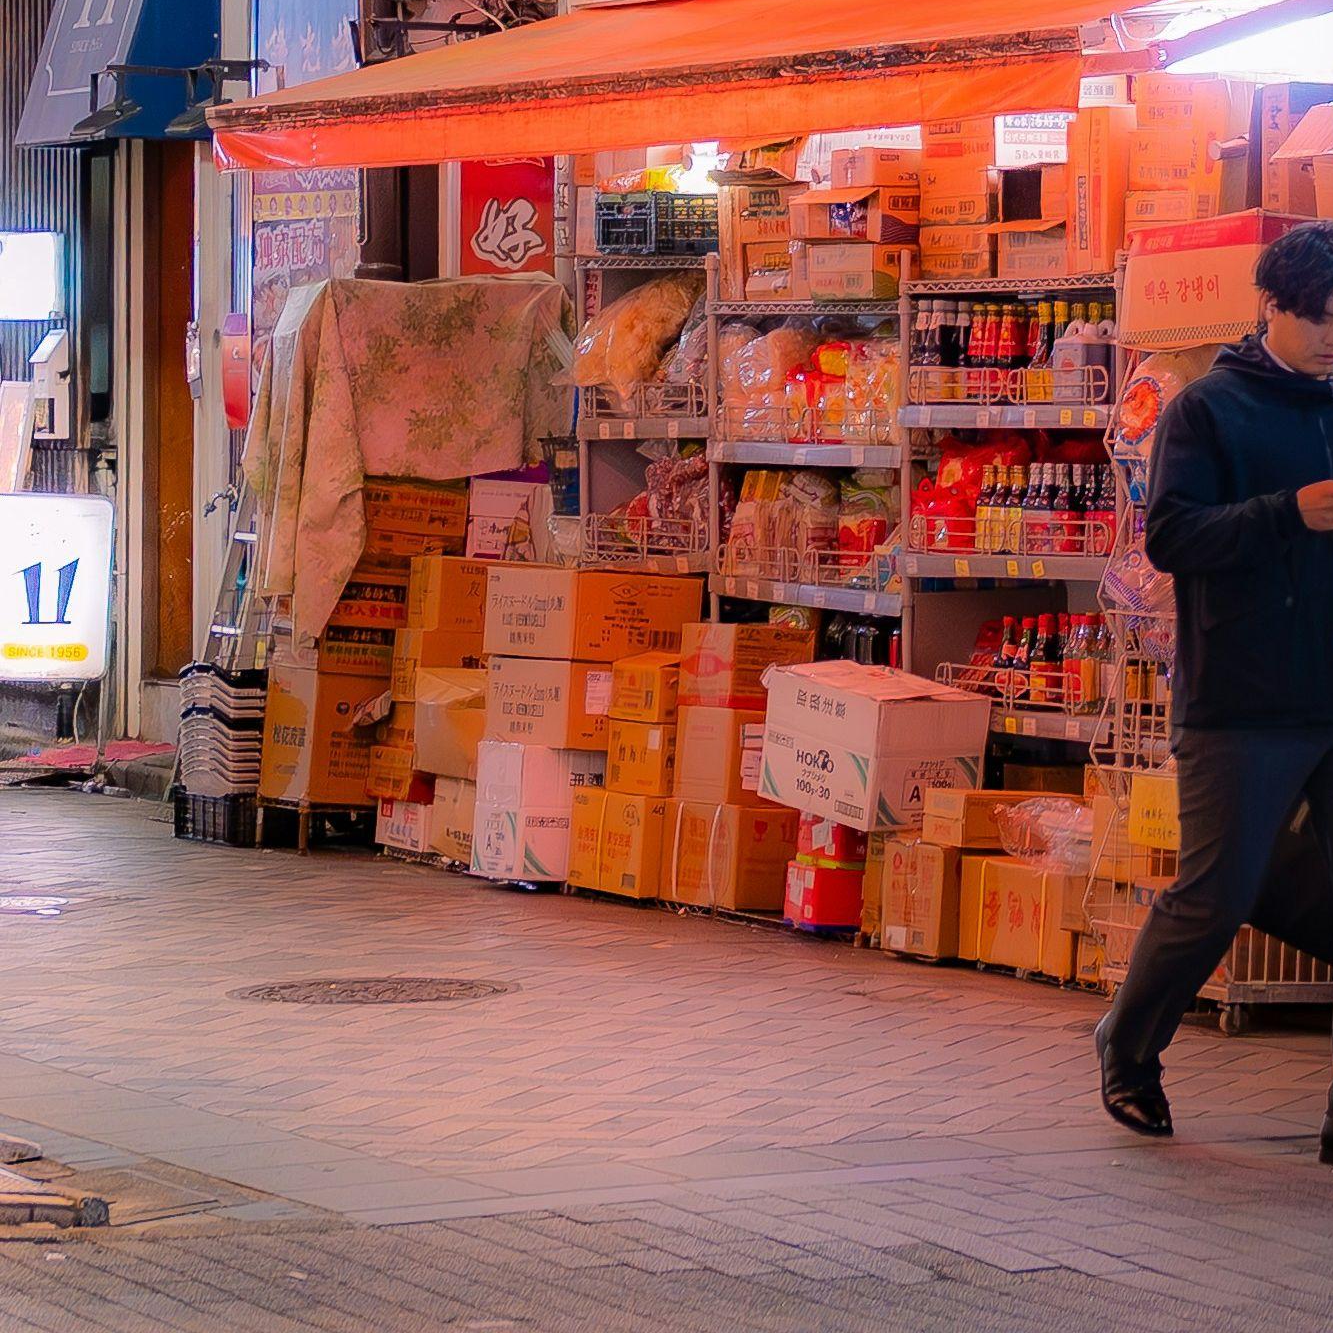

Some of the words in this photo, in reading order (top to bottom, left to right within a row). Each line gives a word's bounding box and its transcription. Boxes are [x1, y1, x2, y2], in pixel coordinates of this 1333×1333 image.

[471, 197, 547, 270] 好
[11, 556, 80, 625] 11
[8, 645, 44, 659] SINCE
[48, 645, 81, 659] 1956
